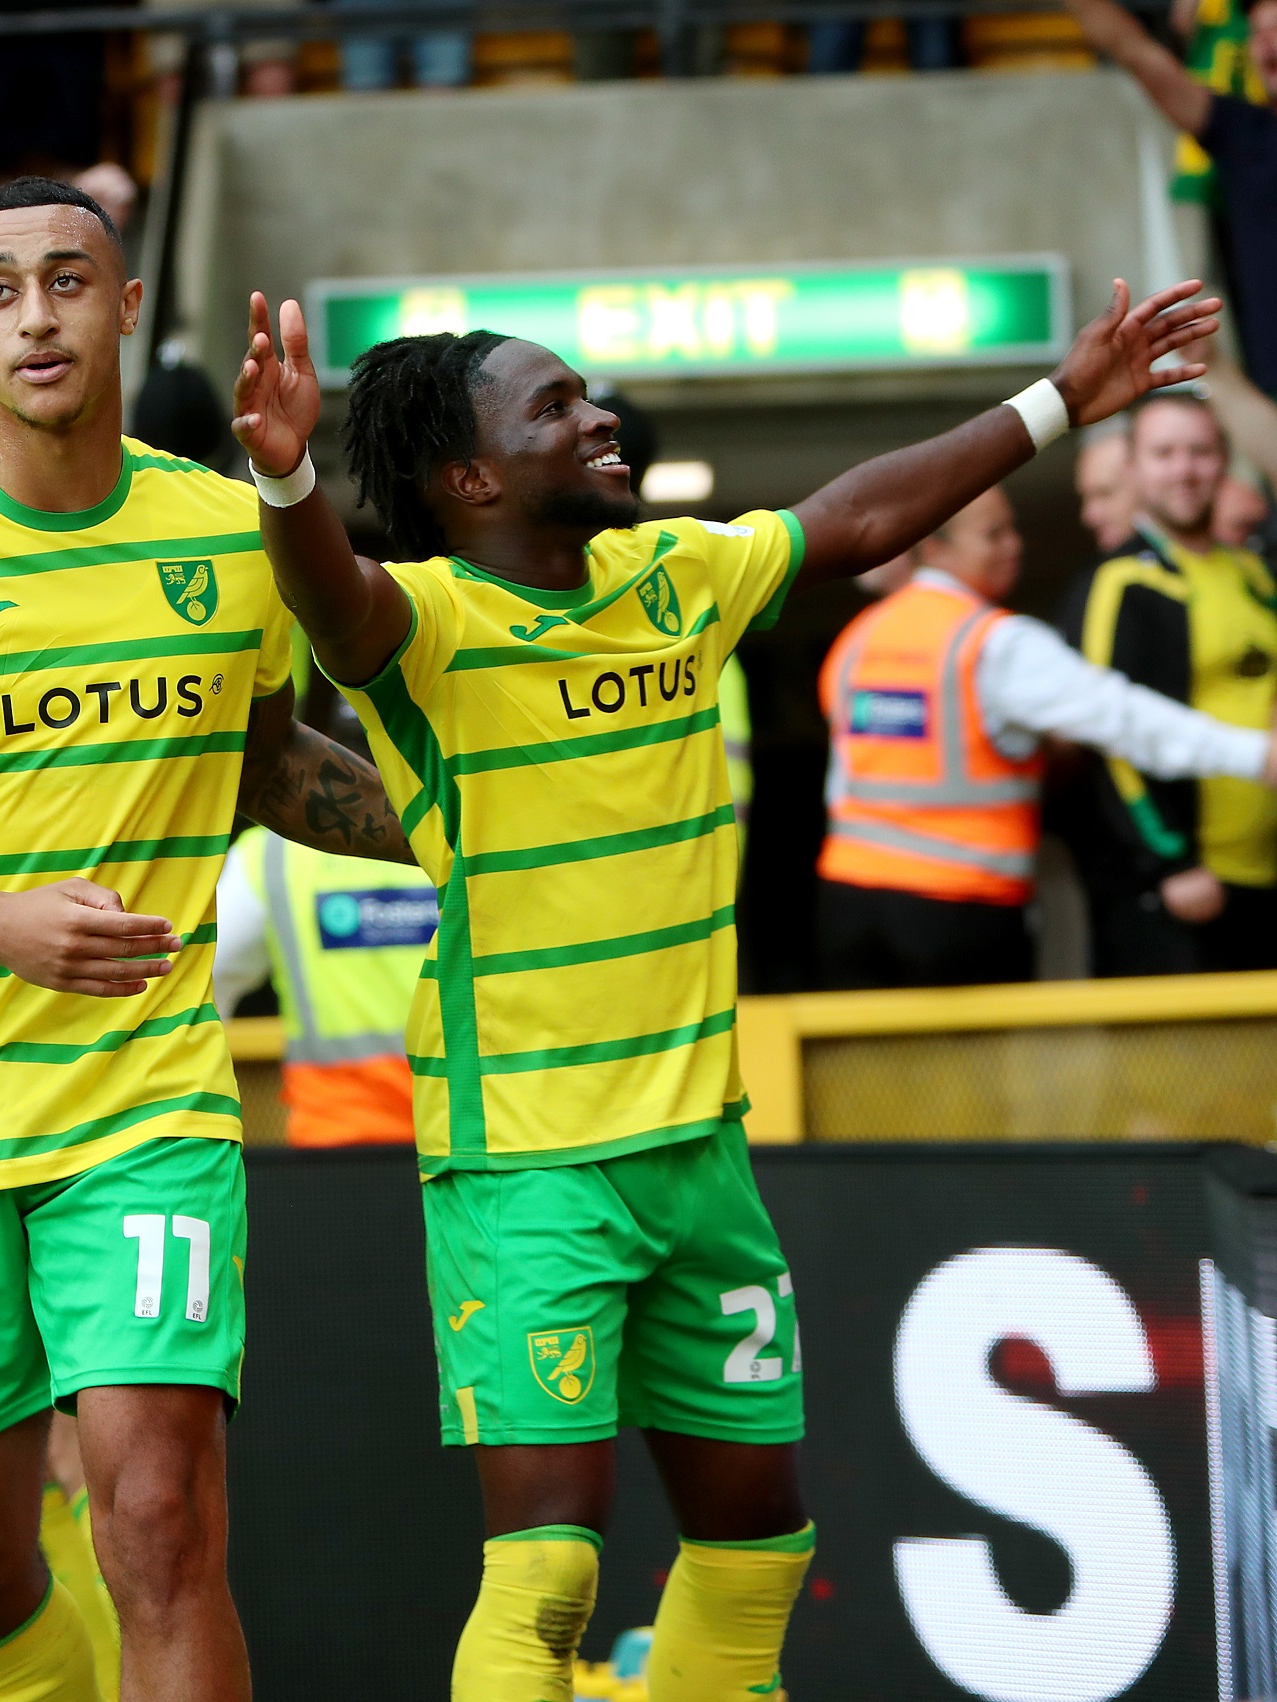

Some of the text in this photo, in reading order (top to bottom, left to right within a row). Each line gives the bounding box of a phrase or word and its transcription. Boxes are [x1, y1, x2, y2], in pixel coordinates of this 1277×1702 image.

[577, 278, 796, 363] EXIT
[1, 674, 204, 736] LOTUS
[557, 654, 697, 720] LOTUS
[123, 1214, 211, 1323] 11
[192, 1312, 202, 1321] EFL
